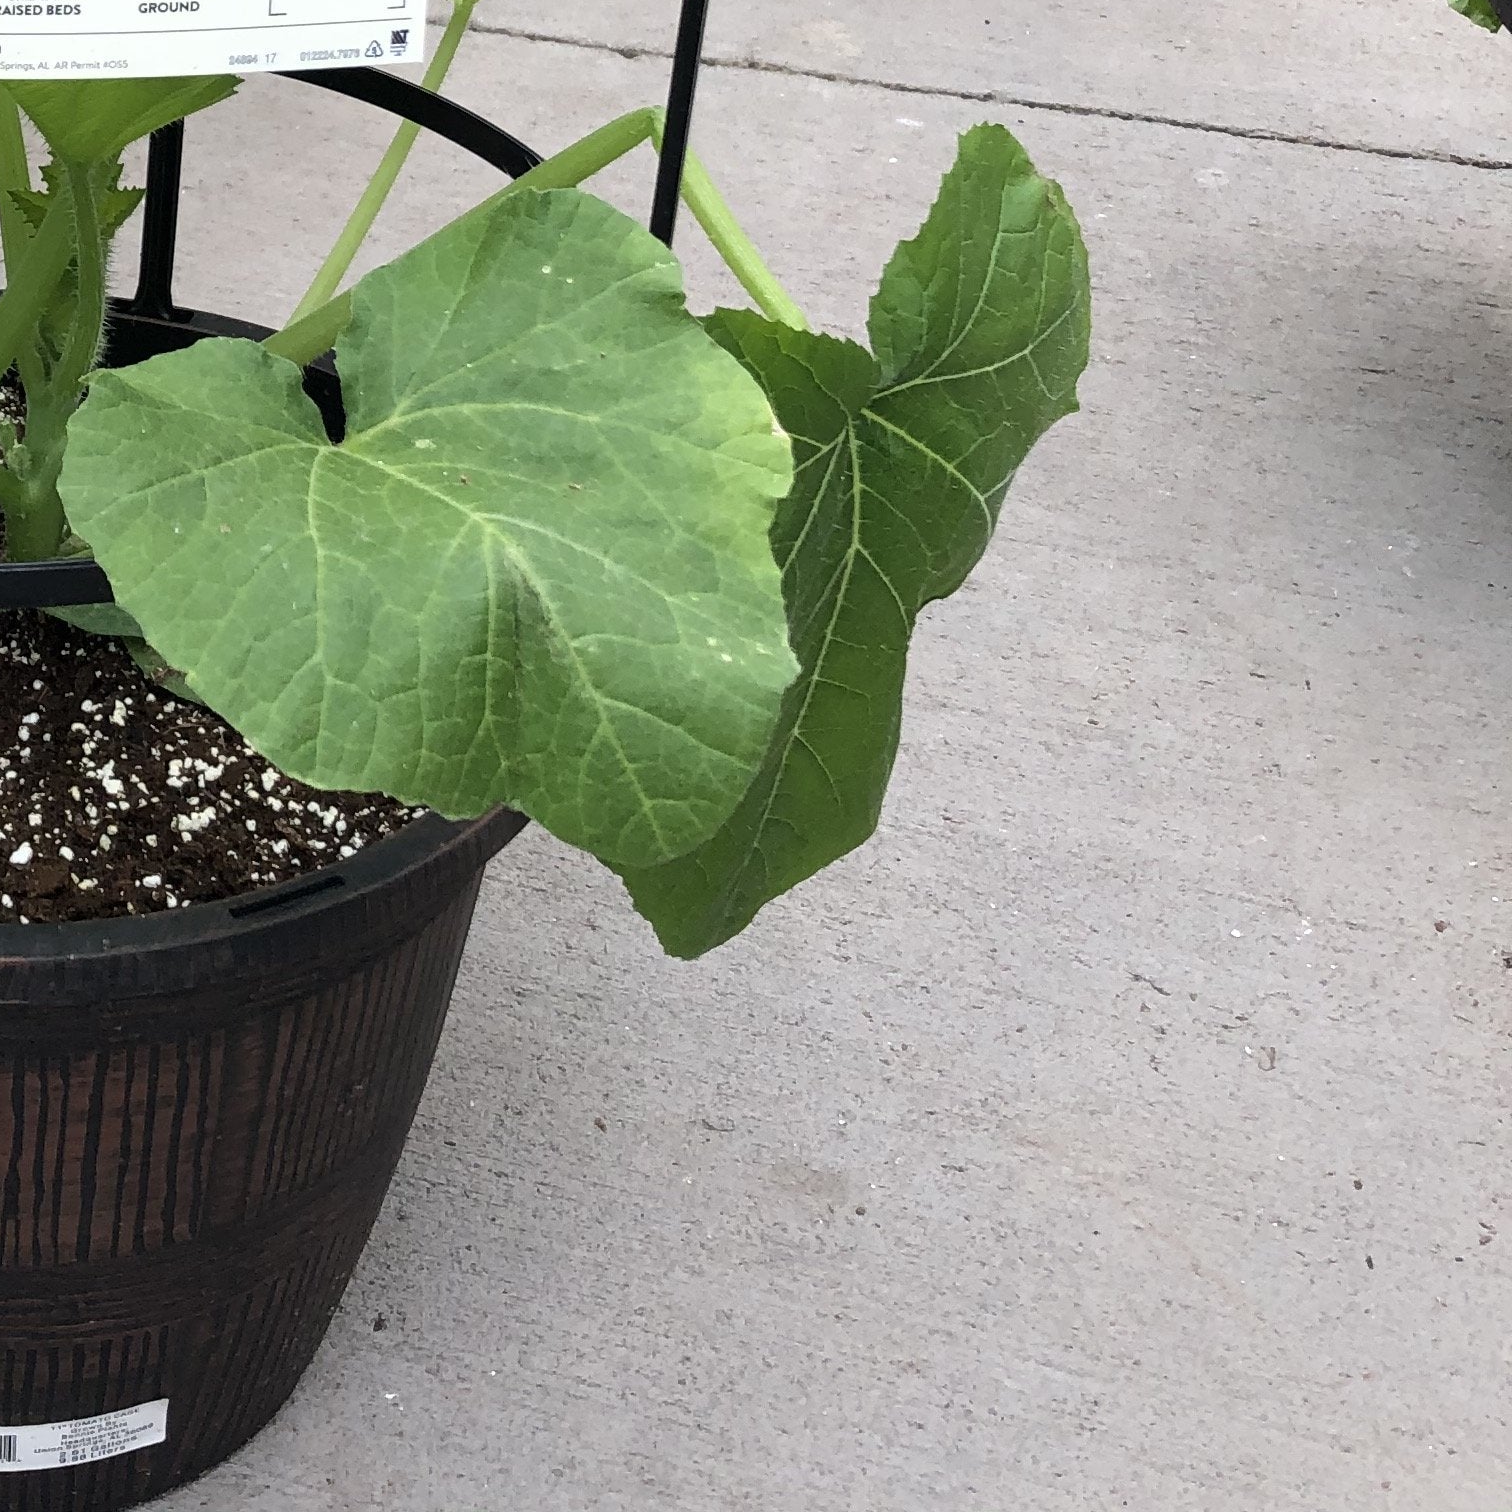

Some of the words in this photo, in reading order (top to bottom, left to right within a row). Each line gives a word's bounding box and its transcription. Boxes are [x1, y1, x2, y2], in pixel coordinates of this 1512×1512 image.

[46, 5, 81, 16] BEDS
[138, 2, 200, 13] GROUND
[265, 53, 276, 64] 17
[0, 61, 35, 71] Springs,
[54, 61, 68, 69] AR
[71, 61, 100, 69] Permit
[90, 1435, 138, 1452] Gallons
[34, 1446, 63, 1454] Union
[90, 1445, 126, 1459] Liters
